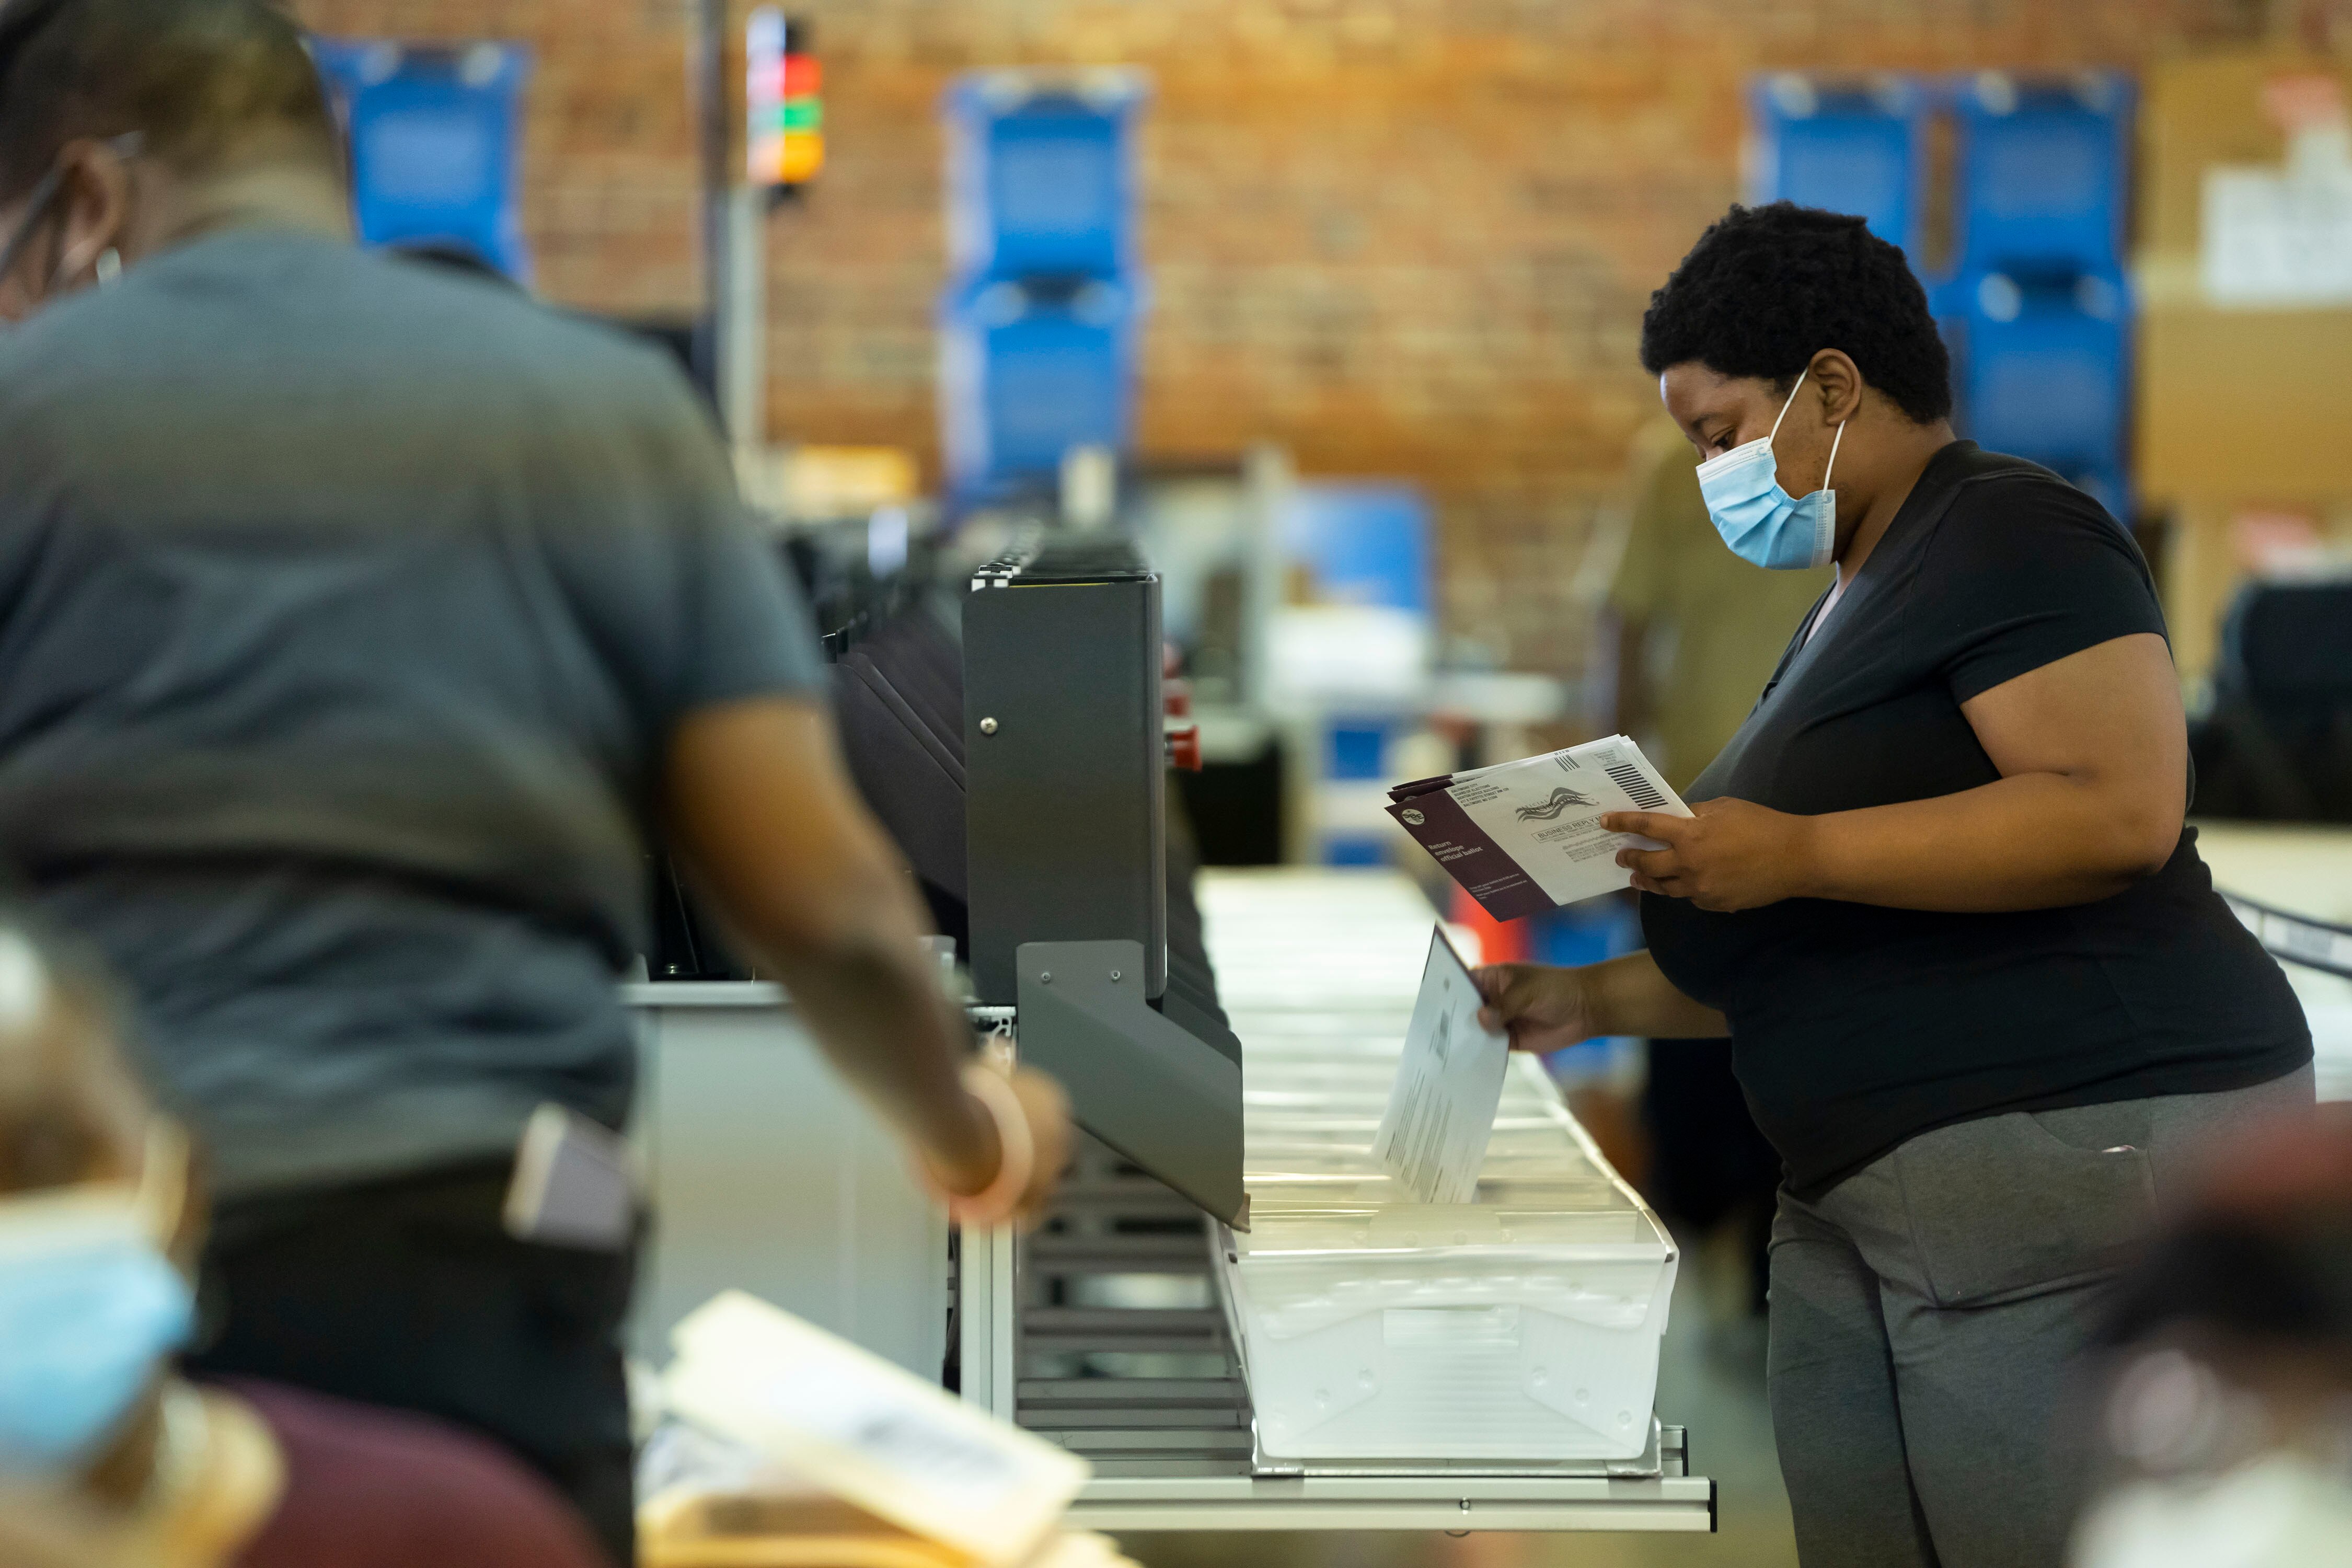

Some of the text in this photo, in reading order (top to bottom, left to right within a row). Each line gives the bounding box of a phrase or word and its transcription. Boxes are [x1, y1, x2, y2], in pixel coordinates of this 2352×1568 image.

[1538, 824, 1573, 838] BUSINESS
[1572, 817, 1595, 828] REPLY
[1428, 841, 1452, 850] Return
[1435, 845, 1465, 856] envelope
[1440, 846, 1483, 862] official ballot
